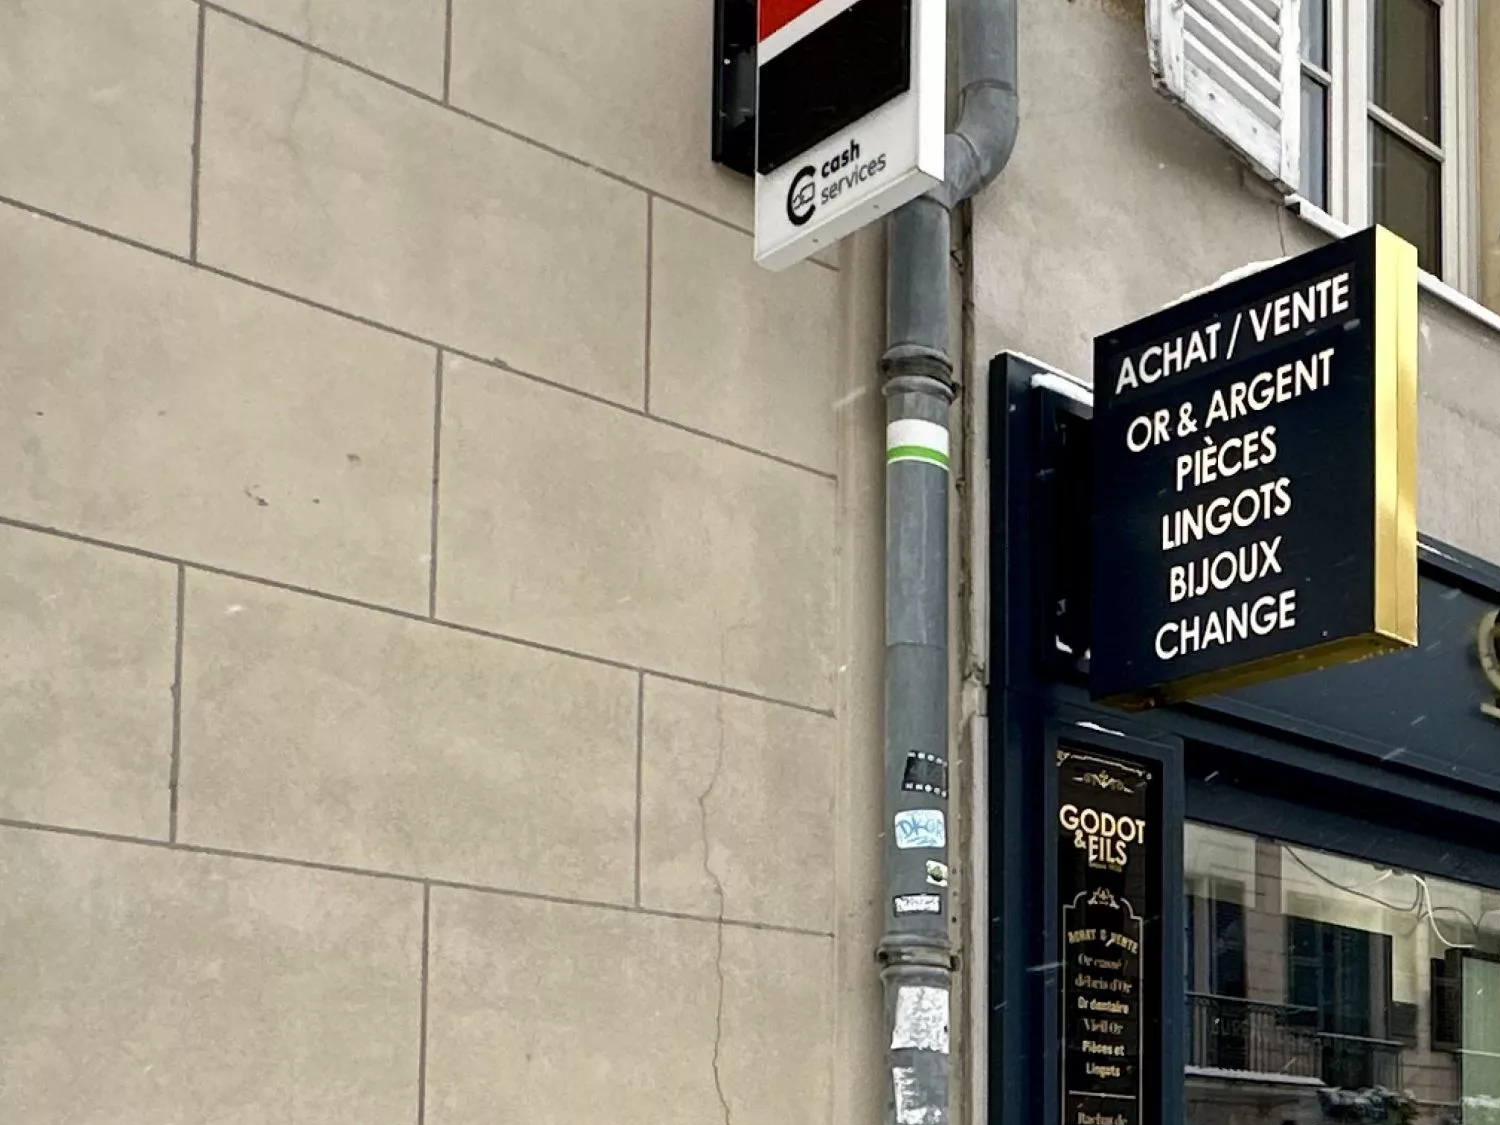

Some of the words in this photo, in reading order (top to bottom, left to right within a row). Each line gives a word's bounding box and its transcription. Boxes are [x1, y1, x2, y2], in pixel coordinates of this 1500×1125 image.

[820, 152, 887, 206] services
[821, 139, 860, 178] cash
[1115, 323, 1221, 394] ACHAT
[1249, 272, 1350, 342] VENTE
[1126, 412, 1171, 453] OR
[1177, 402, 1198, 438] &
[1204, 348, 1334, 428] ARGENT
[1176, 426, 1277, 491] PIÈCES
[1163, 477, 1292, 550] LINGOTS
[1170, 536, 1282, 603] BIJOUX
[1155, 589, 1296, 661] CHANGE
[1059, 804, 1145, 844] GODOT
[1074, 829, 1087, 849] &
[1088, 835, 1128, 866] FILS
